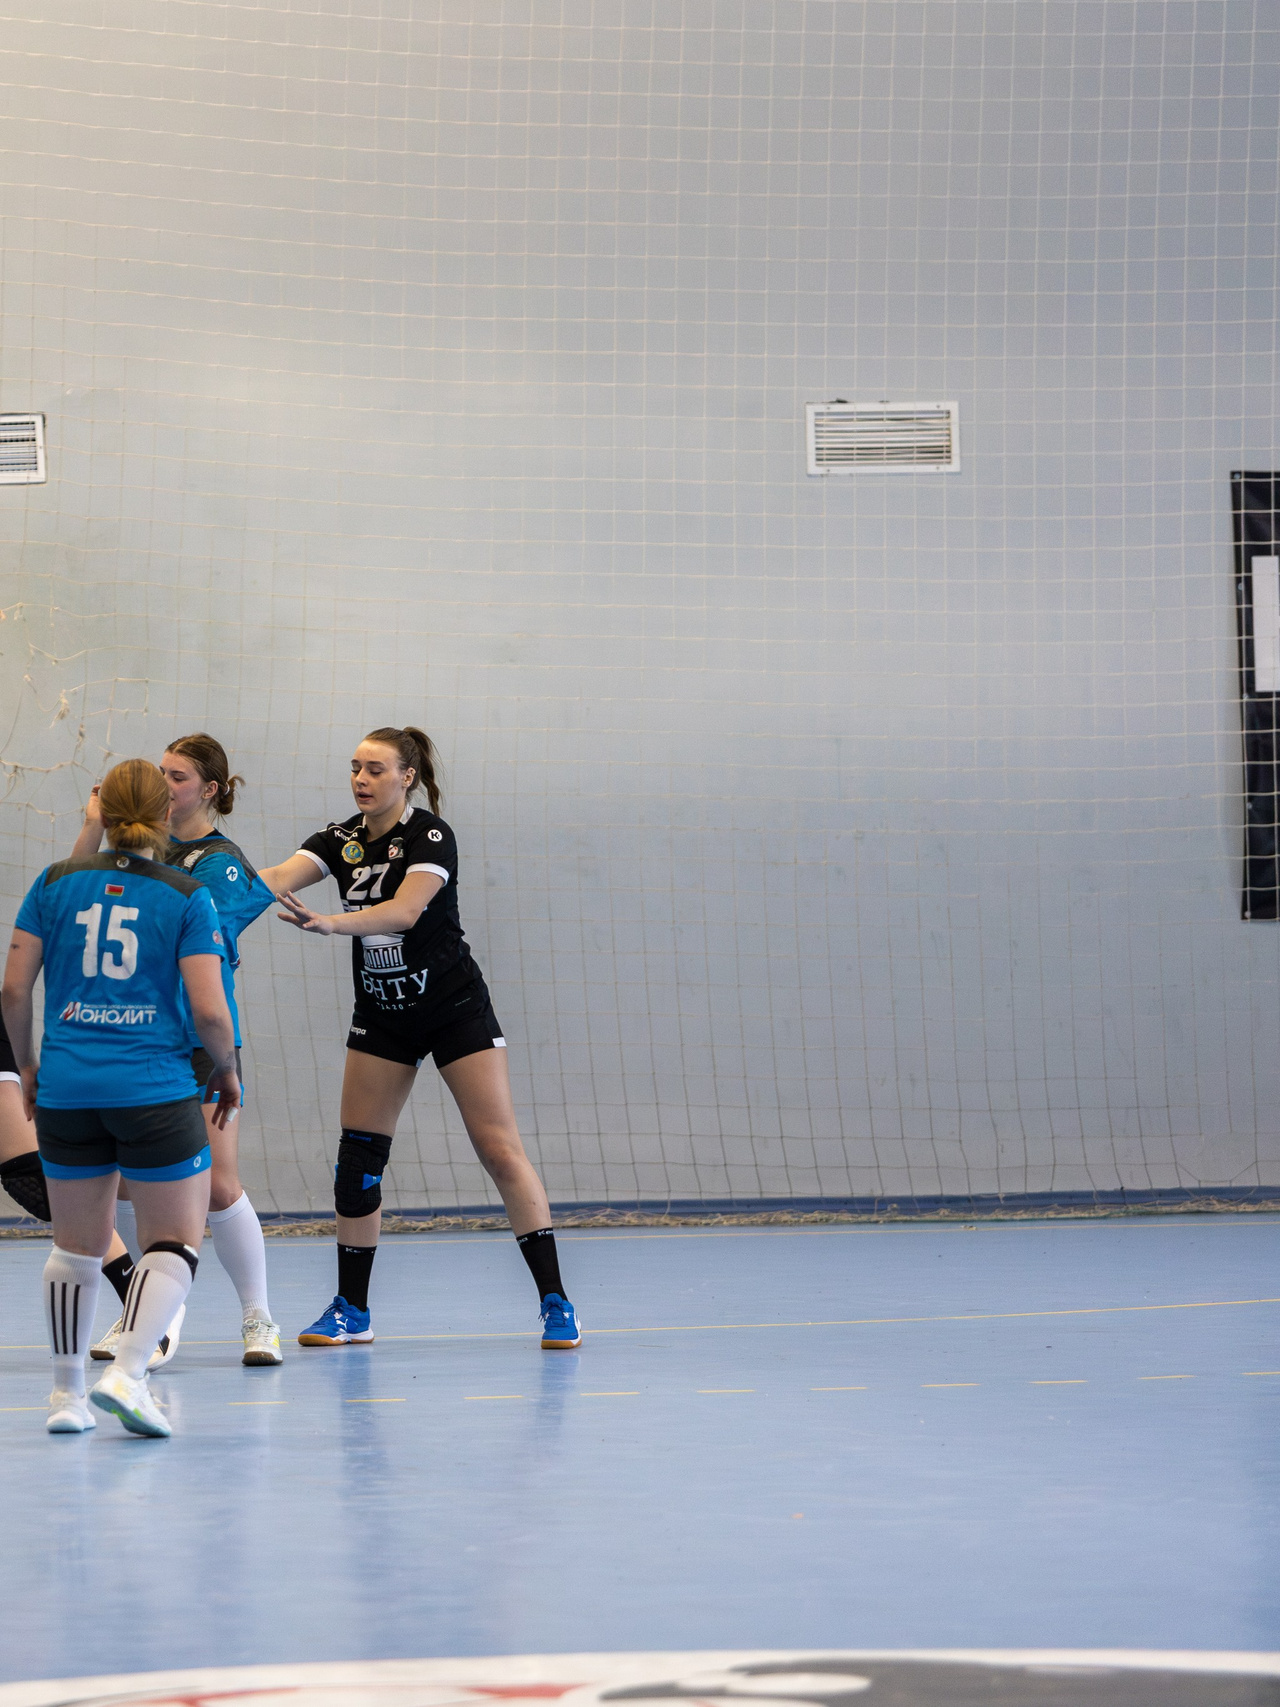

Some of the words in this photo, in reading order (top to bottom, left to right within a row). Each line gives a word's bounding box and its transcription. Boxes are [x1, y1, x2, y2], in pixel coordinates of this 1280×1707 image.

[346, 863, 391, 900] 27
[76, 903, 140, 980] 15
[360, 968, 428, 1001] БНТУ
